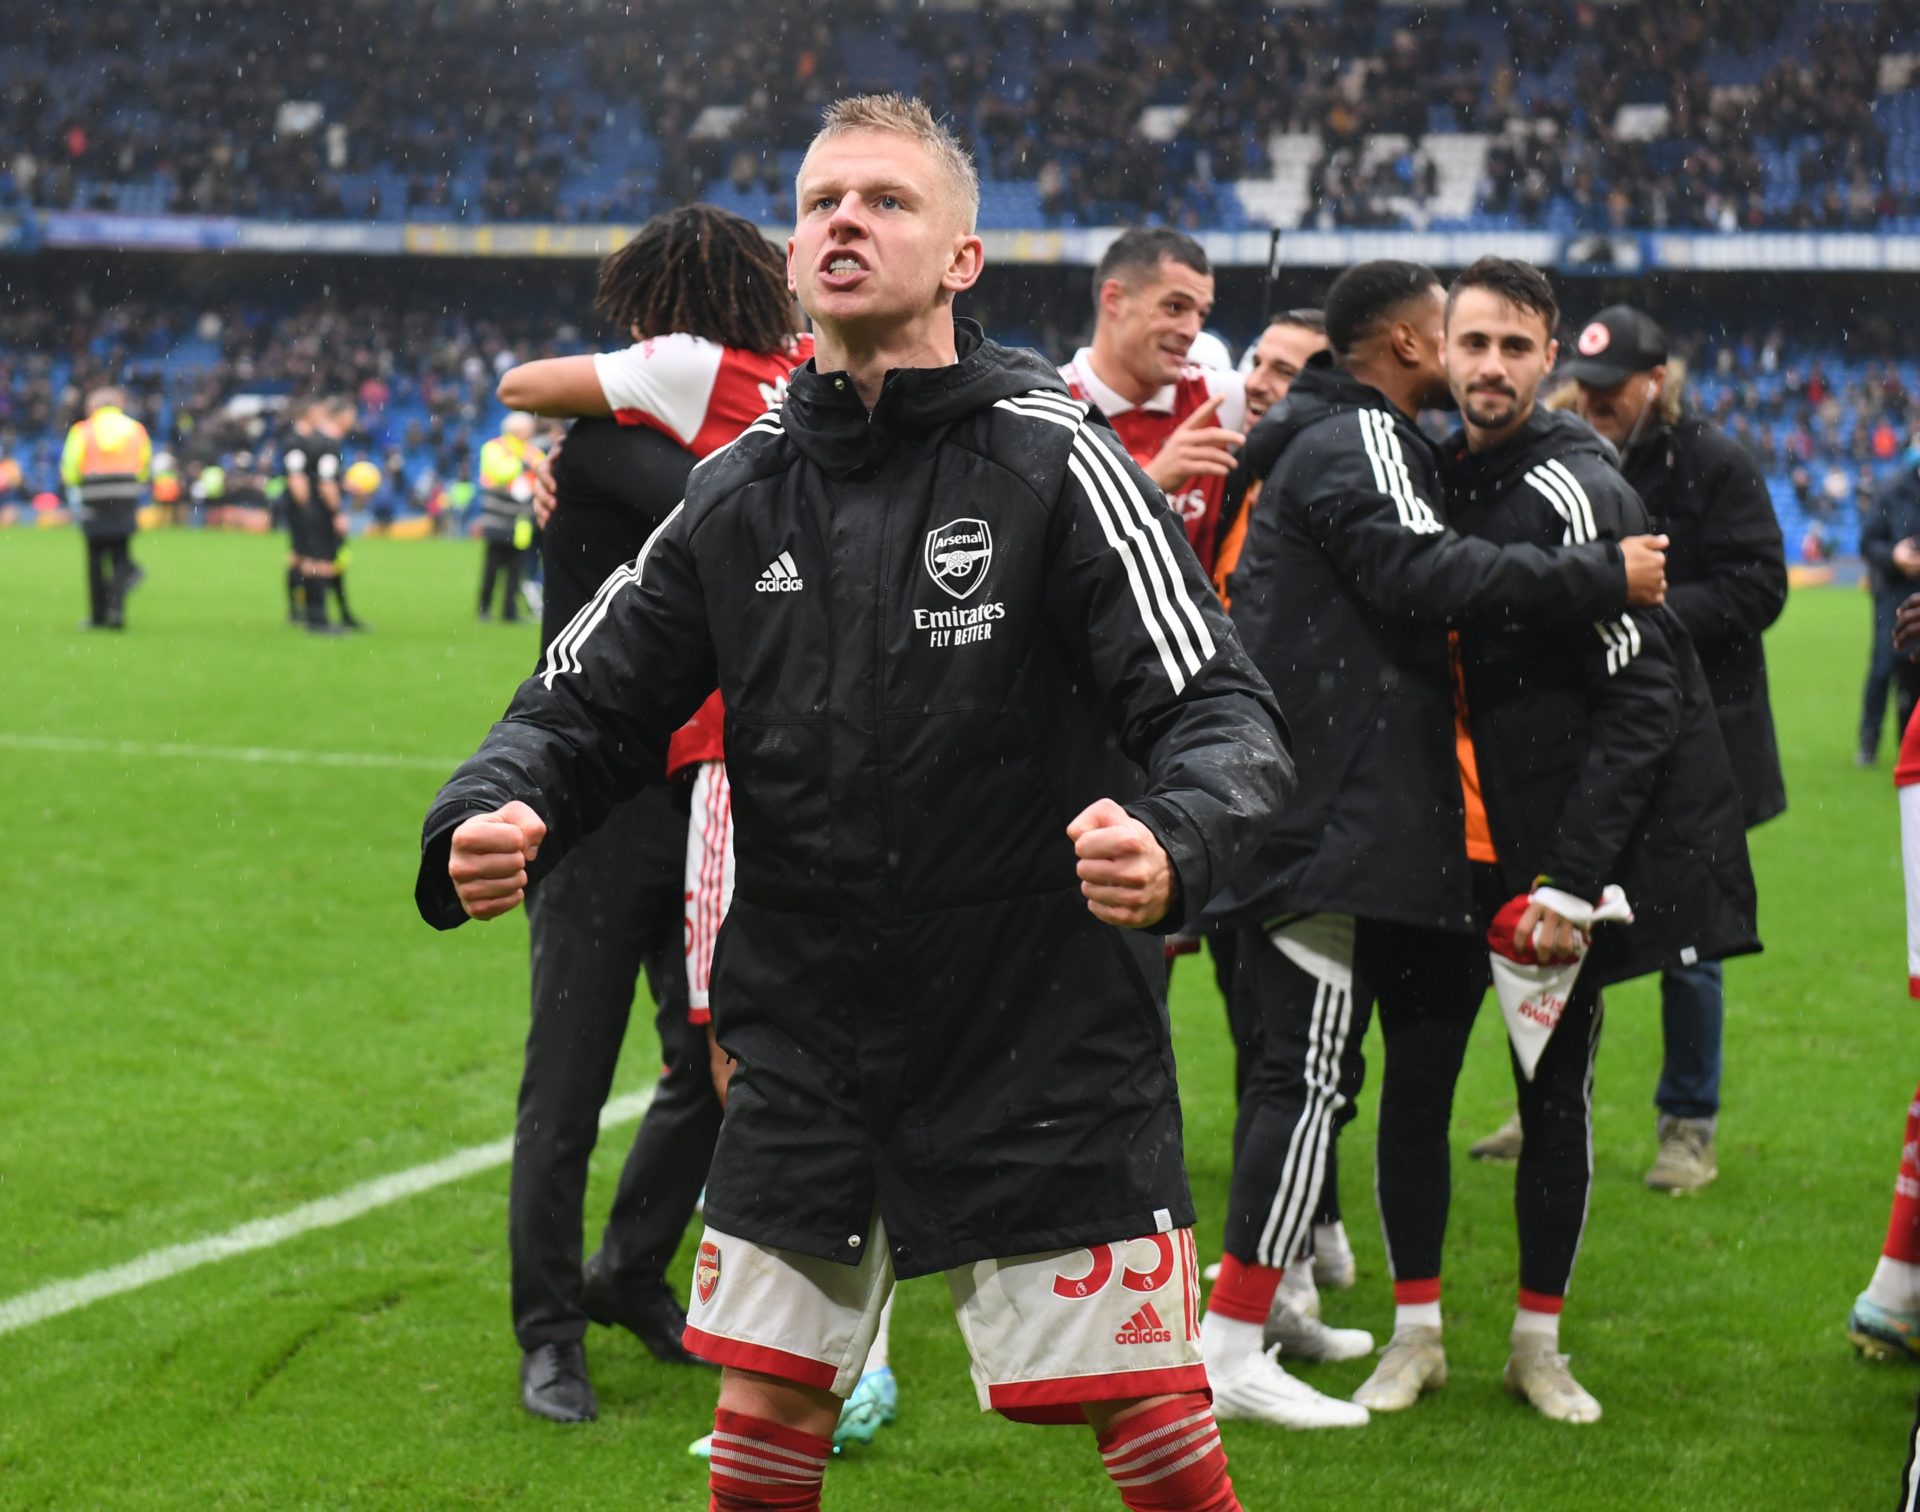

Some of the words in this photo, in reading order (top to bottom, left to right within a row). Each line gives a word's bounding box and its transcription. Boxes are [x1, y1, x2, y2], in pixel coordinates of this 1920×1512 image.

[935, 531, 983, 549] Arsenal
[755, 577, 803, 592] adidas
[913, 603, 1005, 630] Emirates
[930, 629, 951, 648] FLY
[954, 622, 992, 646] BETTER
[1115, 1328, 1172, 1345] adidas
